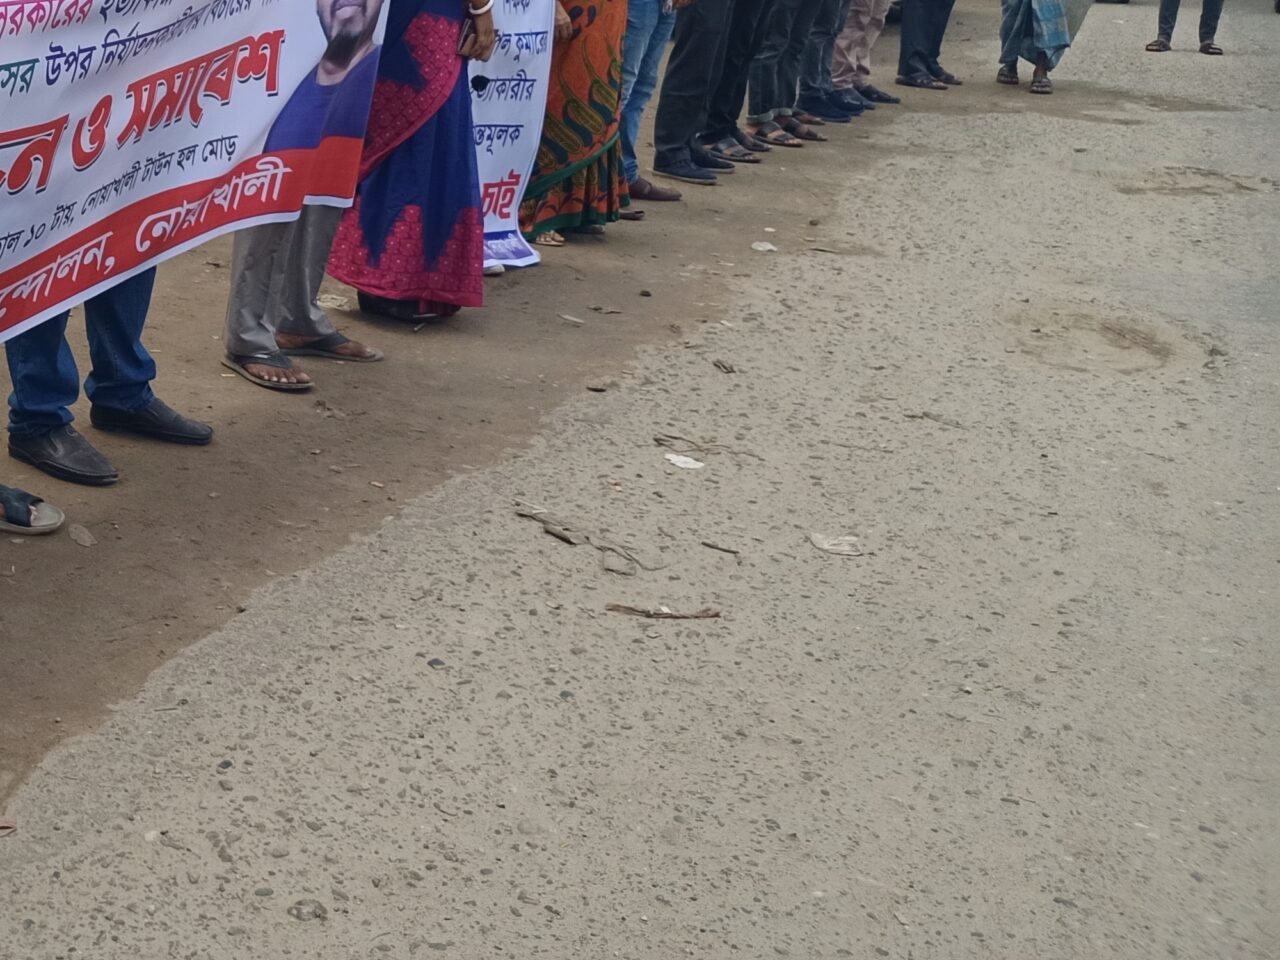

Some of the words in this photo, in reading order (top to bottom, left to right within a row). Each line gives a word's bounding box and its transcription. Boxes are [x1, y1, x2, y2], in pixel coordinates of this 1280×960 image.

[45, 41, 97, 86] উপর
[71, 94, 113, 172] ও
[116, 28, 286, 150] সমাবেশ
[23, 222, 46, 247] ১০
[81, 160, 141, 215] নোয়াখালী
[142, 150, 175, 182] টাউন
[177, 144, 199, 171] হল
[202, 135, 239, 162] মোড়
[135, 157, 293, 253] নোয়াখালী
